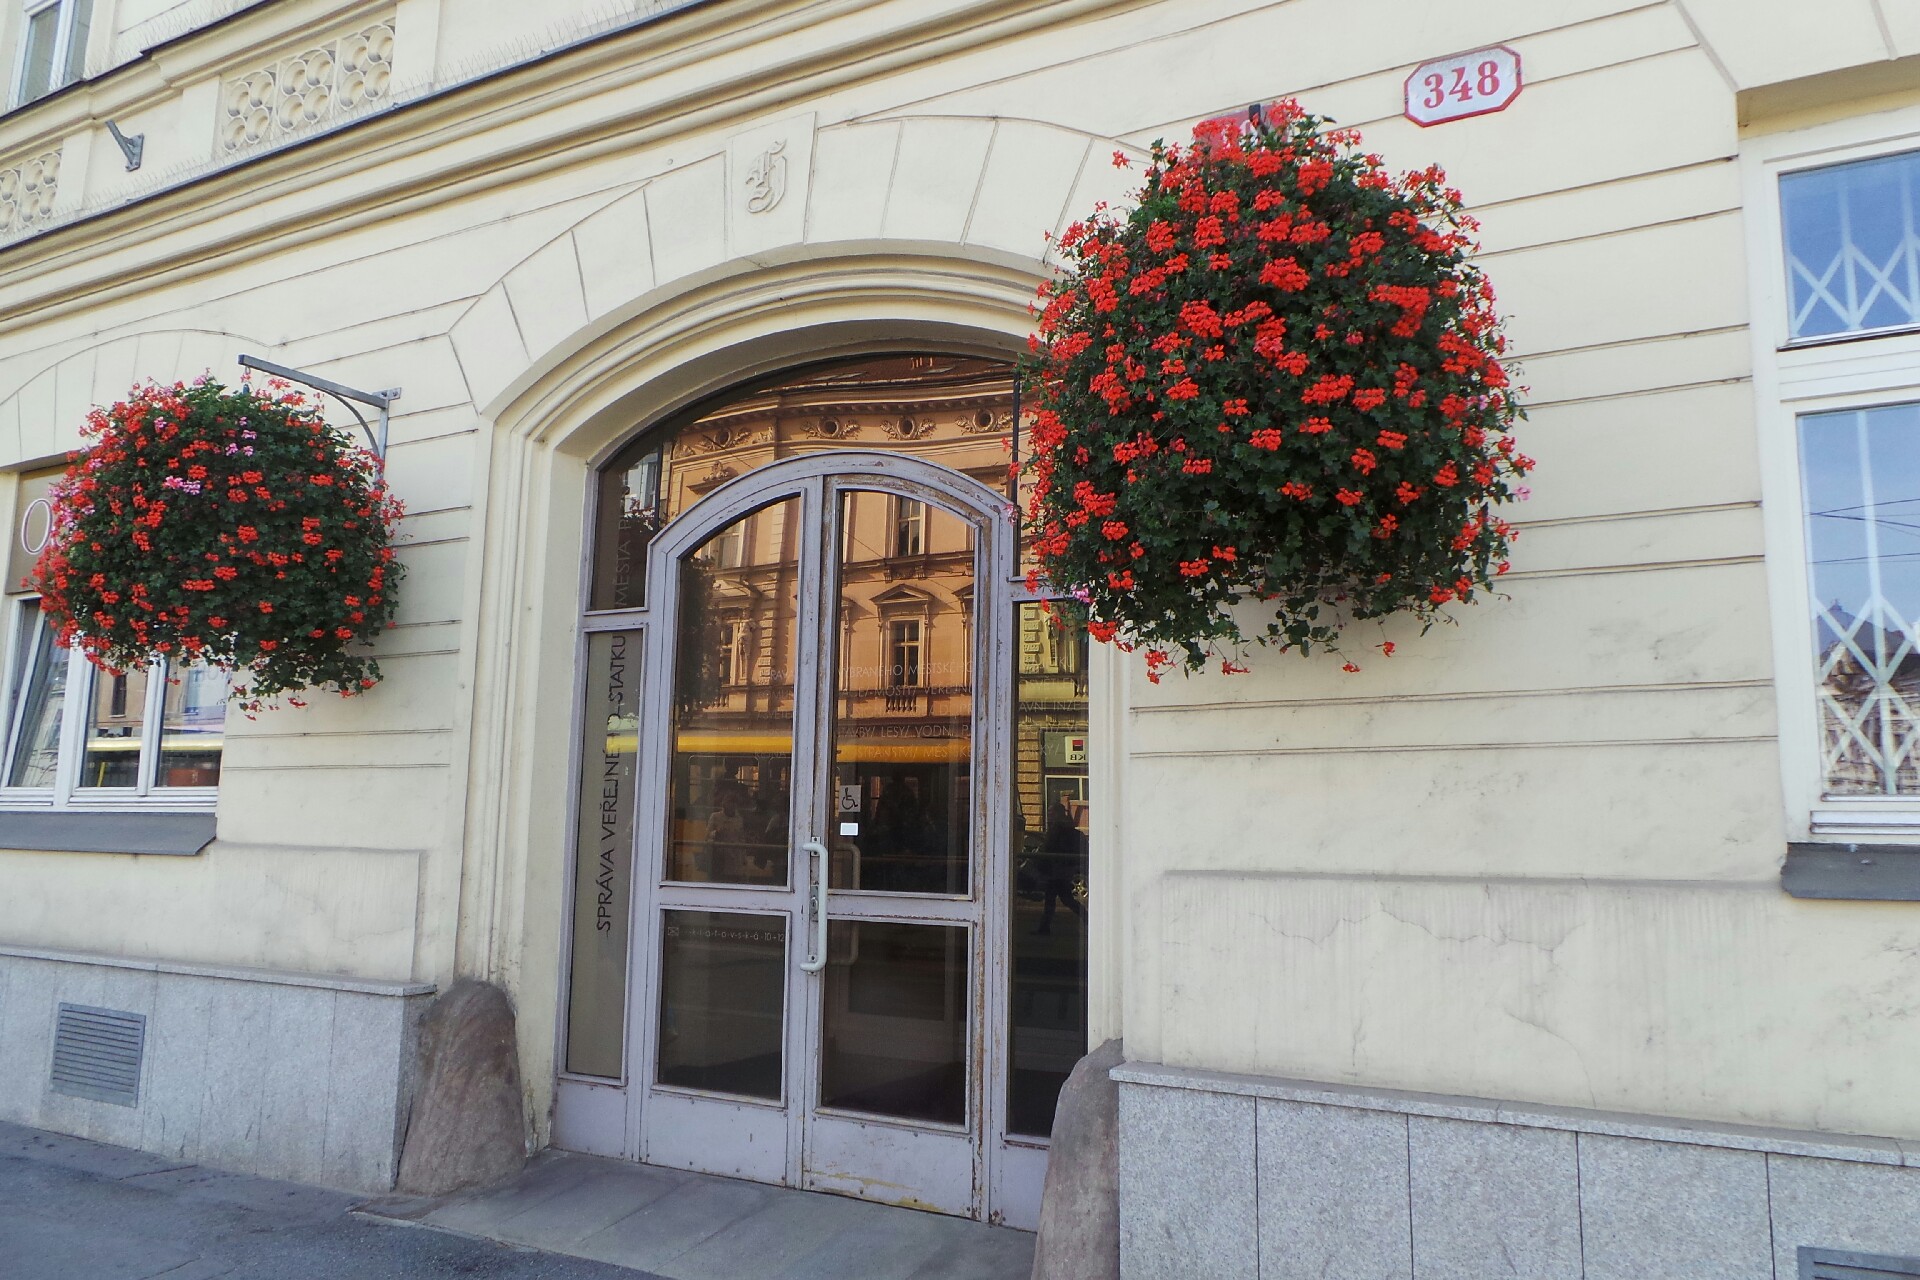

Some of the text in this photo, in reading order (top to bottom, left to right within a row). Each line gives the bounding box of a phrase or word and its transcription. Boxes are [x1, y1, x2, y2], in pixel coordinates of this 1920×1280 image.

[1423, 60, 1500, 109] 348
[595, 847, 616, 932] SPRÁVA
[607, 635, 626, 704] STATKU
